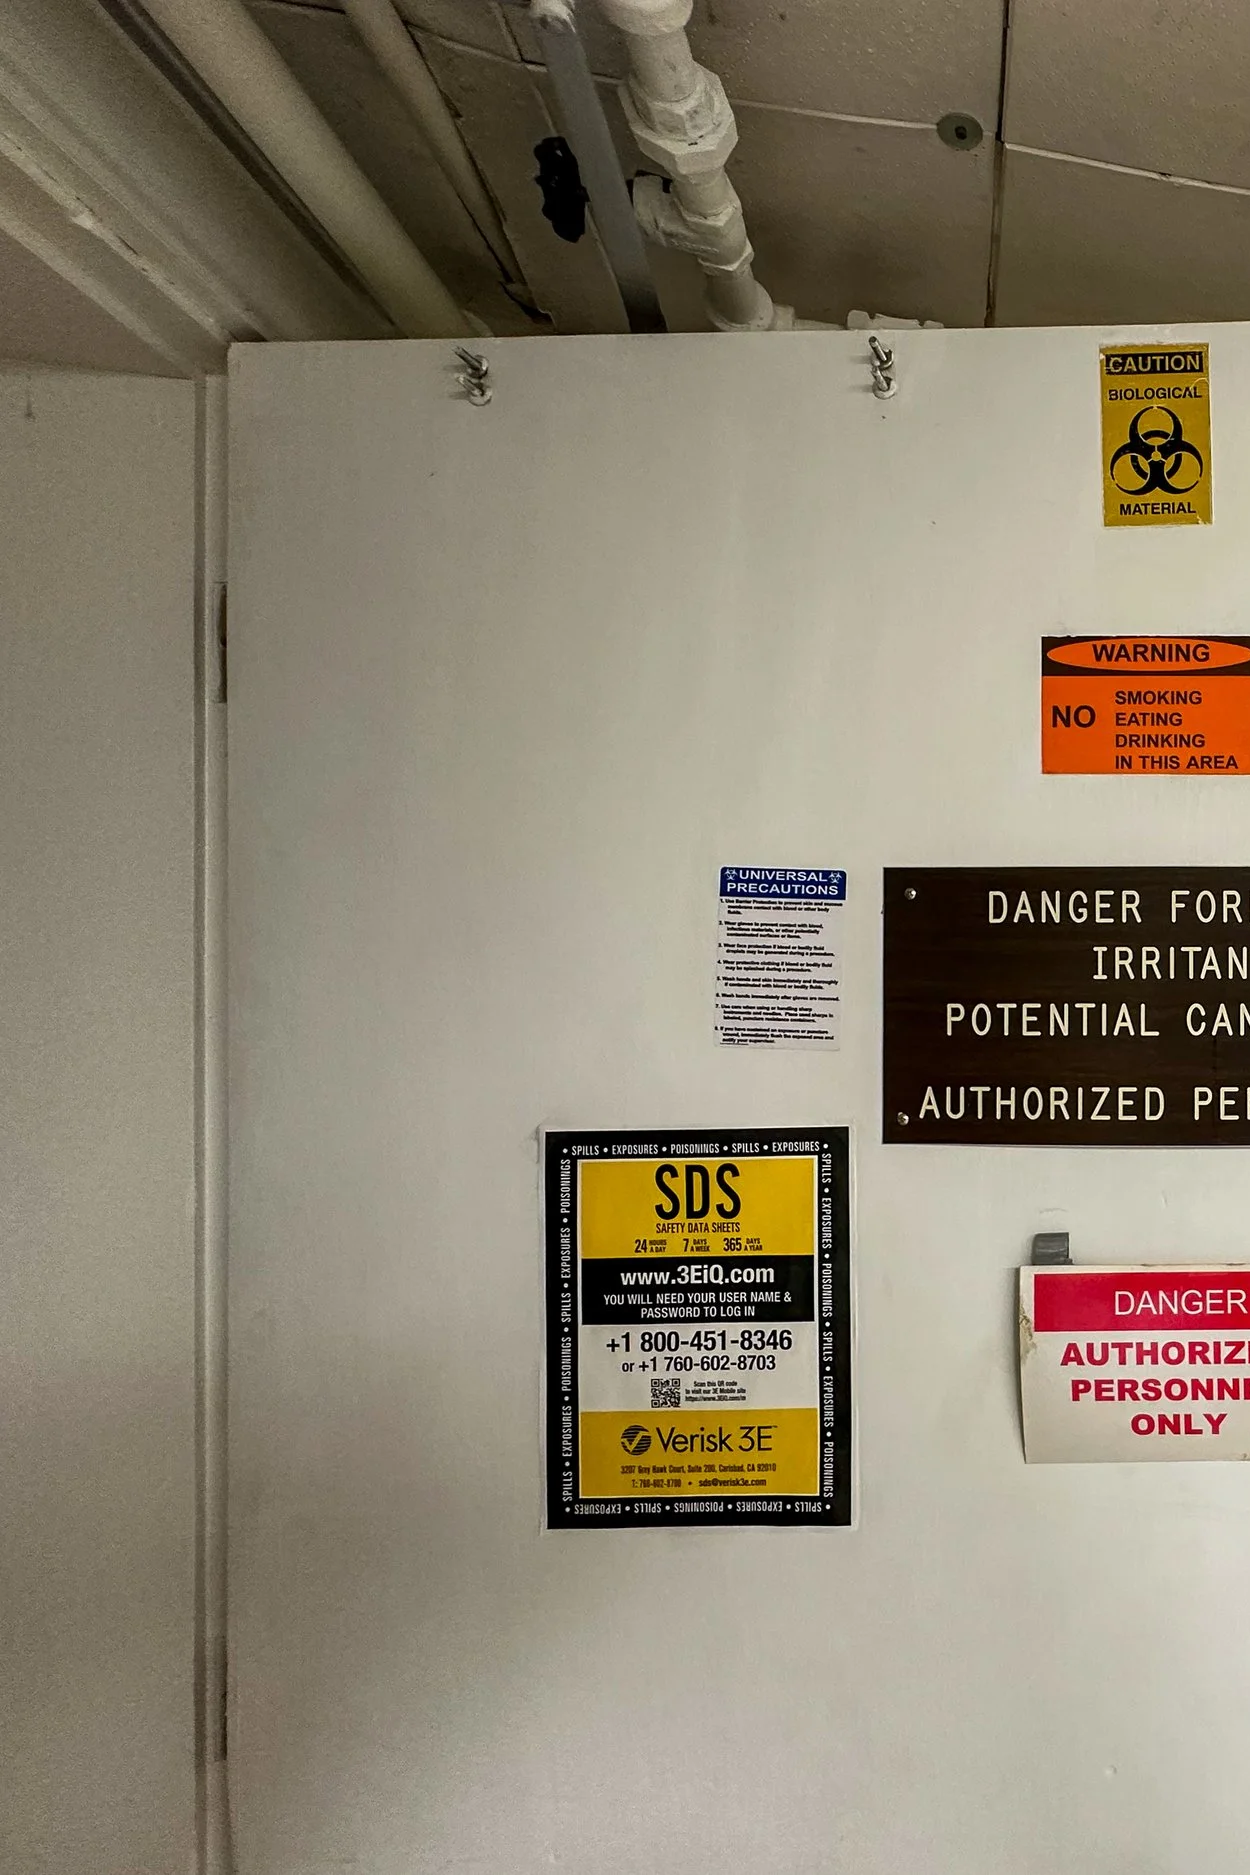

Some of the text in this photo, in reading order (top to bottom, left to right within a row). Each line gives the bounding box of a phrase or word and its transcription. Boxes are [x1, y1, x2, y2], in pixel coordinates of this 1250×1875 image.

[1109, 355, 1200, 373] CAUTION
[1109, 386, 1202, 401] BIOLOGICAL
[1120, 502, 1196, 515] MATERIAL
[1092, 643, 1210, 662] WARNING
[1115, 690, 1202, 705] SMOKING
[1052, 705, 1096, 728] NO
[1115, 712, 1183, 726] EATING
[1115, 734, 1205, 748] DRINKING
[1115, 755, 1238, 769] IN THIS AREA
[739, 870, 828, 882] UNIVERSAL
[726, 882, 838, 895] PRECAUTIONS
[987, 890, 1142, 925] DANGER
[945, 1003, 1161, 1037] POTENTIAL
[919, 1086, 1166, 1121] AUTHORIZED
[571, 1141, 820, 1156] SPILLS EXPOSURES POISONINGS SPILLS EXPOSURES
[655, 1162, 742, 1220] SDS
[656, 1222, 740, 1234] SAFETY DATA SHEETS
[634, 1238, 742, 1253] 24 7 365
[620, 1264, 775, 1285] www.3EiQ.com
[604, 1291, 792, 1305] YOU WILL NEED YOUR USER NAME &
[1114, 1289, 1248, 1316] DANGER
[640, 1306, 755, 1319] PASSWORD TO LOG IN
[560, 1159, 573, 1501] SPILLS EXPOSURES POISONINGS SPILLS EXPOSURES POISONINGS
[821, 1153, 834, 1498] SPILLS EXPOSURES POISONINGS SPILLS EXPOSURES POISONINGS
[606, 1329, 793, 1352] +1 800-451-8346
[621, 1354, 776, 1373] or +1 760-602-8703
[1131, 1413, 1228, 1435] ONLY
[656, 1427, 735, 1453] Verisk
[621, 1465, 636, 1474] 3207
[747, 1464, 755, 1472] CA
[698, 1478, 767, 1487] sds@verisk3e.com
[574, 1502, 822, 1515] SPILLS EXPOSURES POISONINGS SPILLS EXPOSURES
